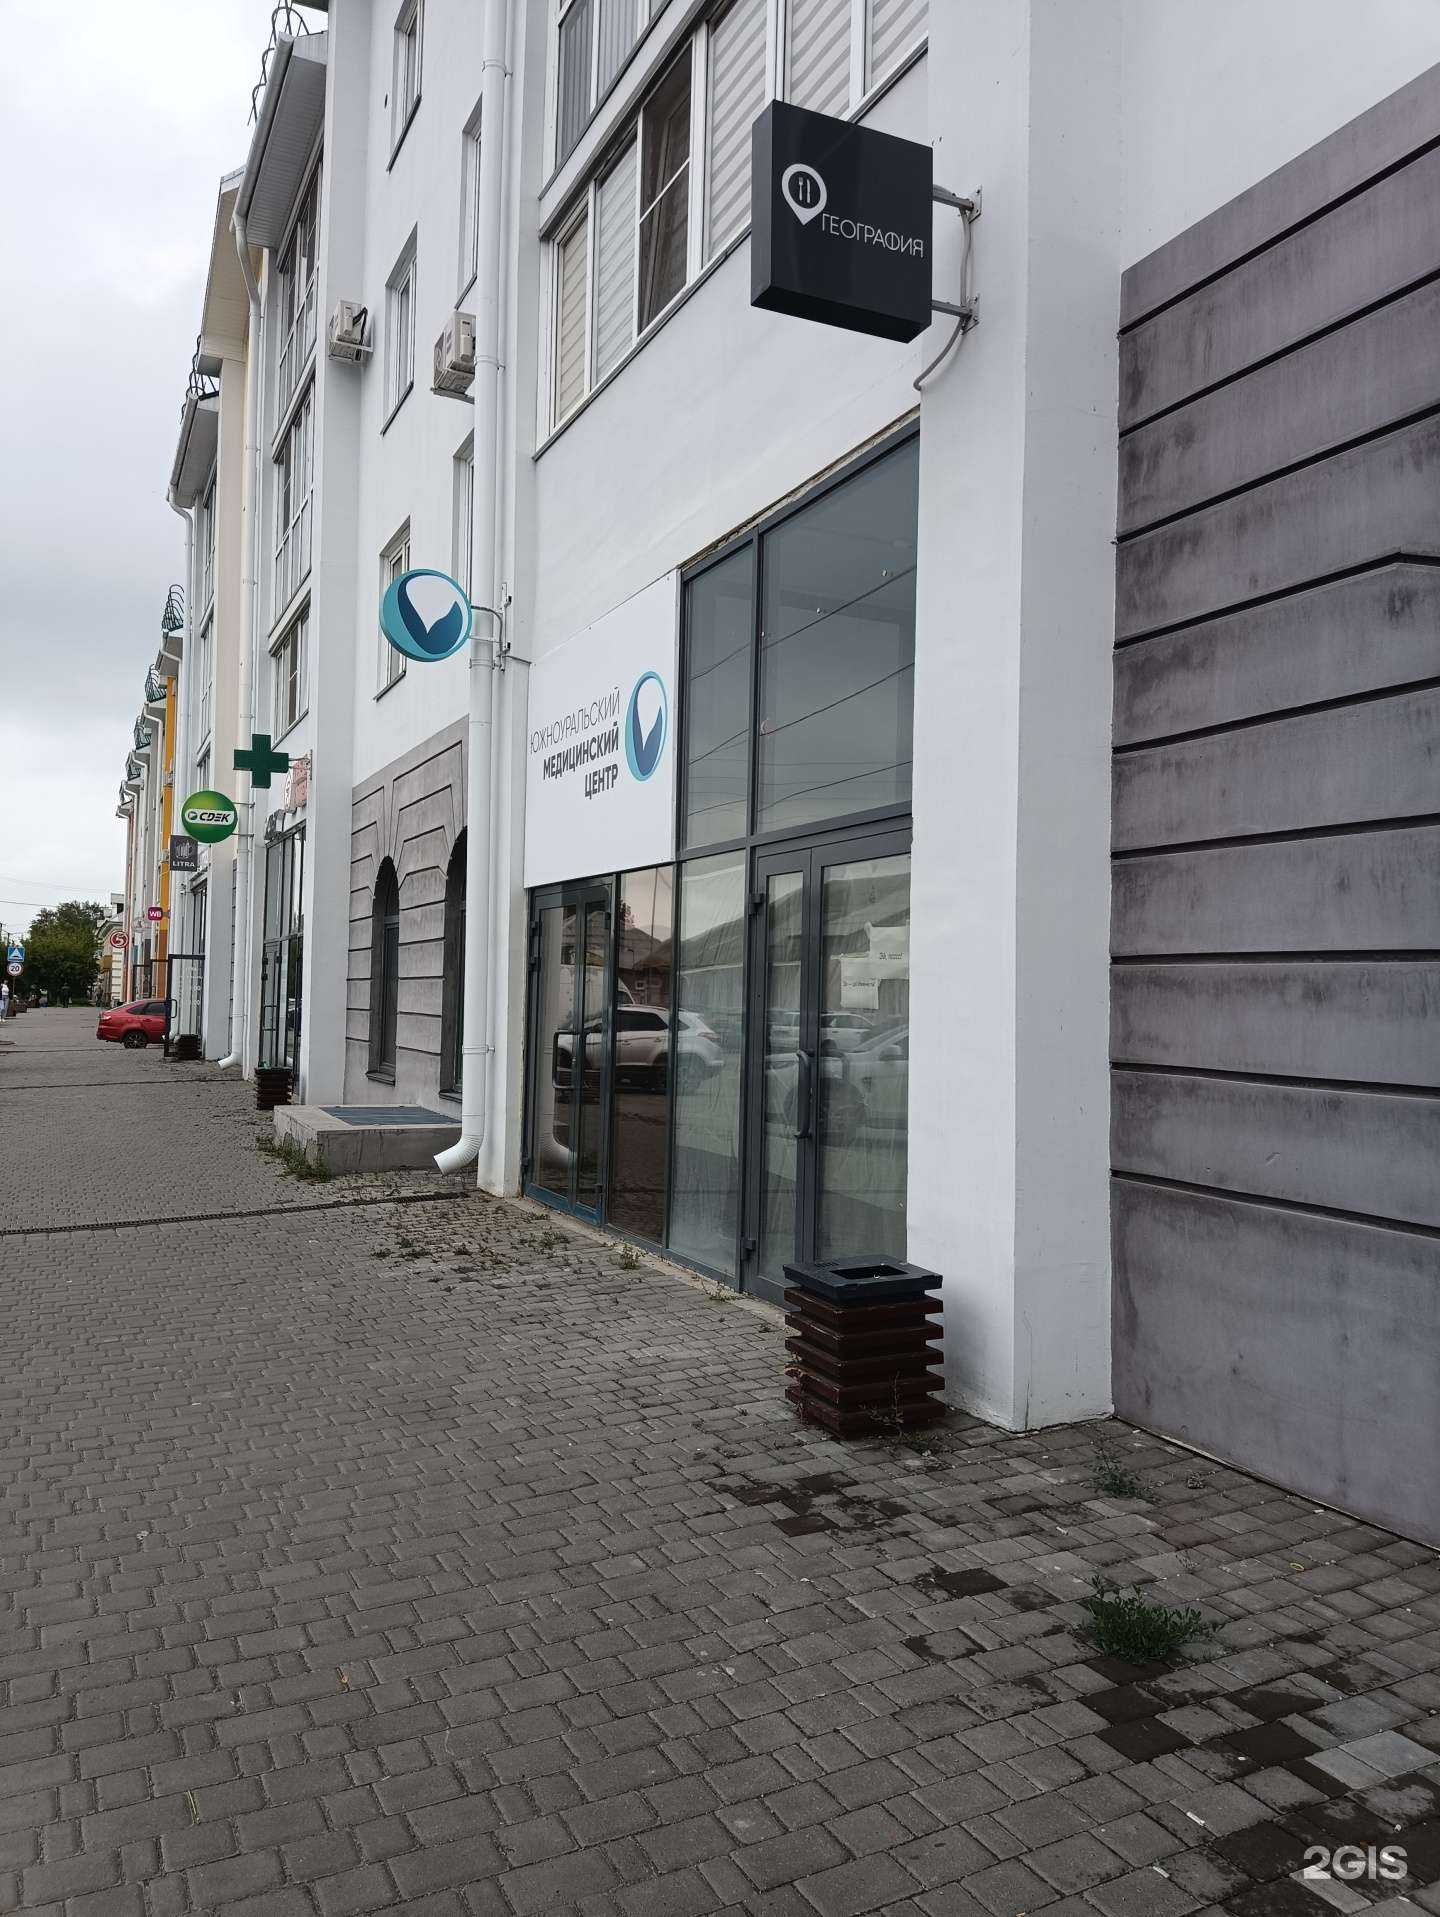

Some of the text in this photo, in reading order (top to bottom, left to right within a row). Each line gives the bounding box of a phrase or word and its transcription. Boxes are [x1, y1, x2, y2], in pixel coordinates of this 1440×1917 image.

[821, 212, 924, 258] ГЕОГРАФИЯ
[530, 686, 620, 755] ЮЖНОУРАЛЬСКИЙ
[543, 720, 619, 780] МЕДИЦИНСКИЙ
[584, 763, 619, 800] ЦЕНТР
[200, 812, 230, 823] CDEK
[172, 860, 196, 868] LITRA
